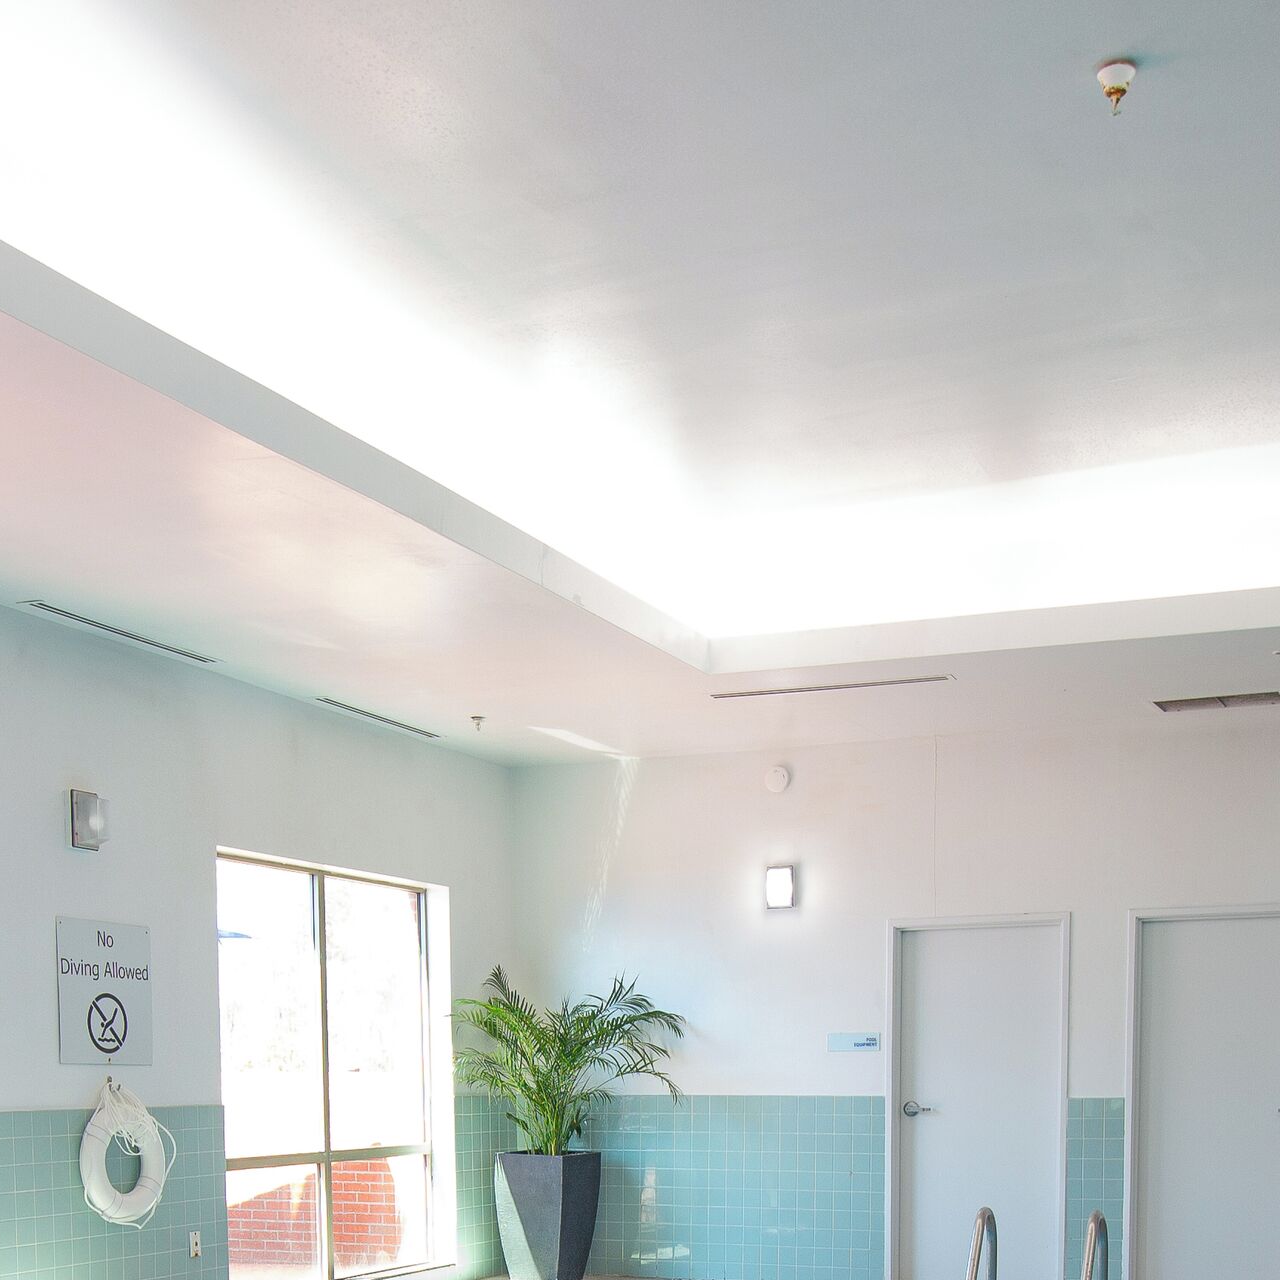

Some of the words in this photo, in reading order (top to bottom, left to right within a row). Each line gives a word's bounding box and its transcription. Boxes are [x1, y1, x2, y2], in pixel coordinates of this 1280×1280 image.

[97, 930, 114, 948] No
[61, 958, 99, 980] Diving
[104, 962, 149, 981] Allowed
